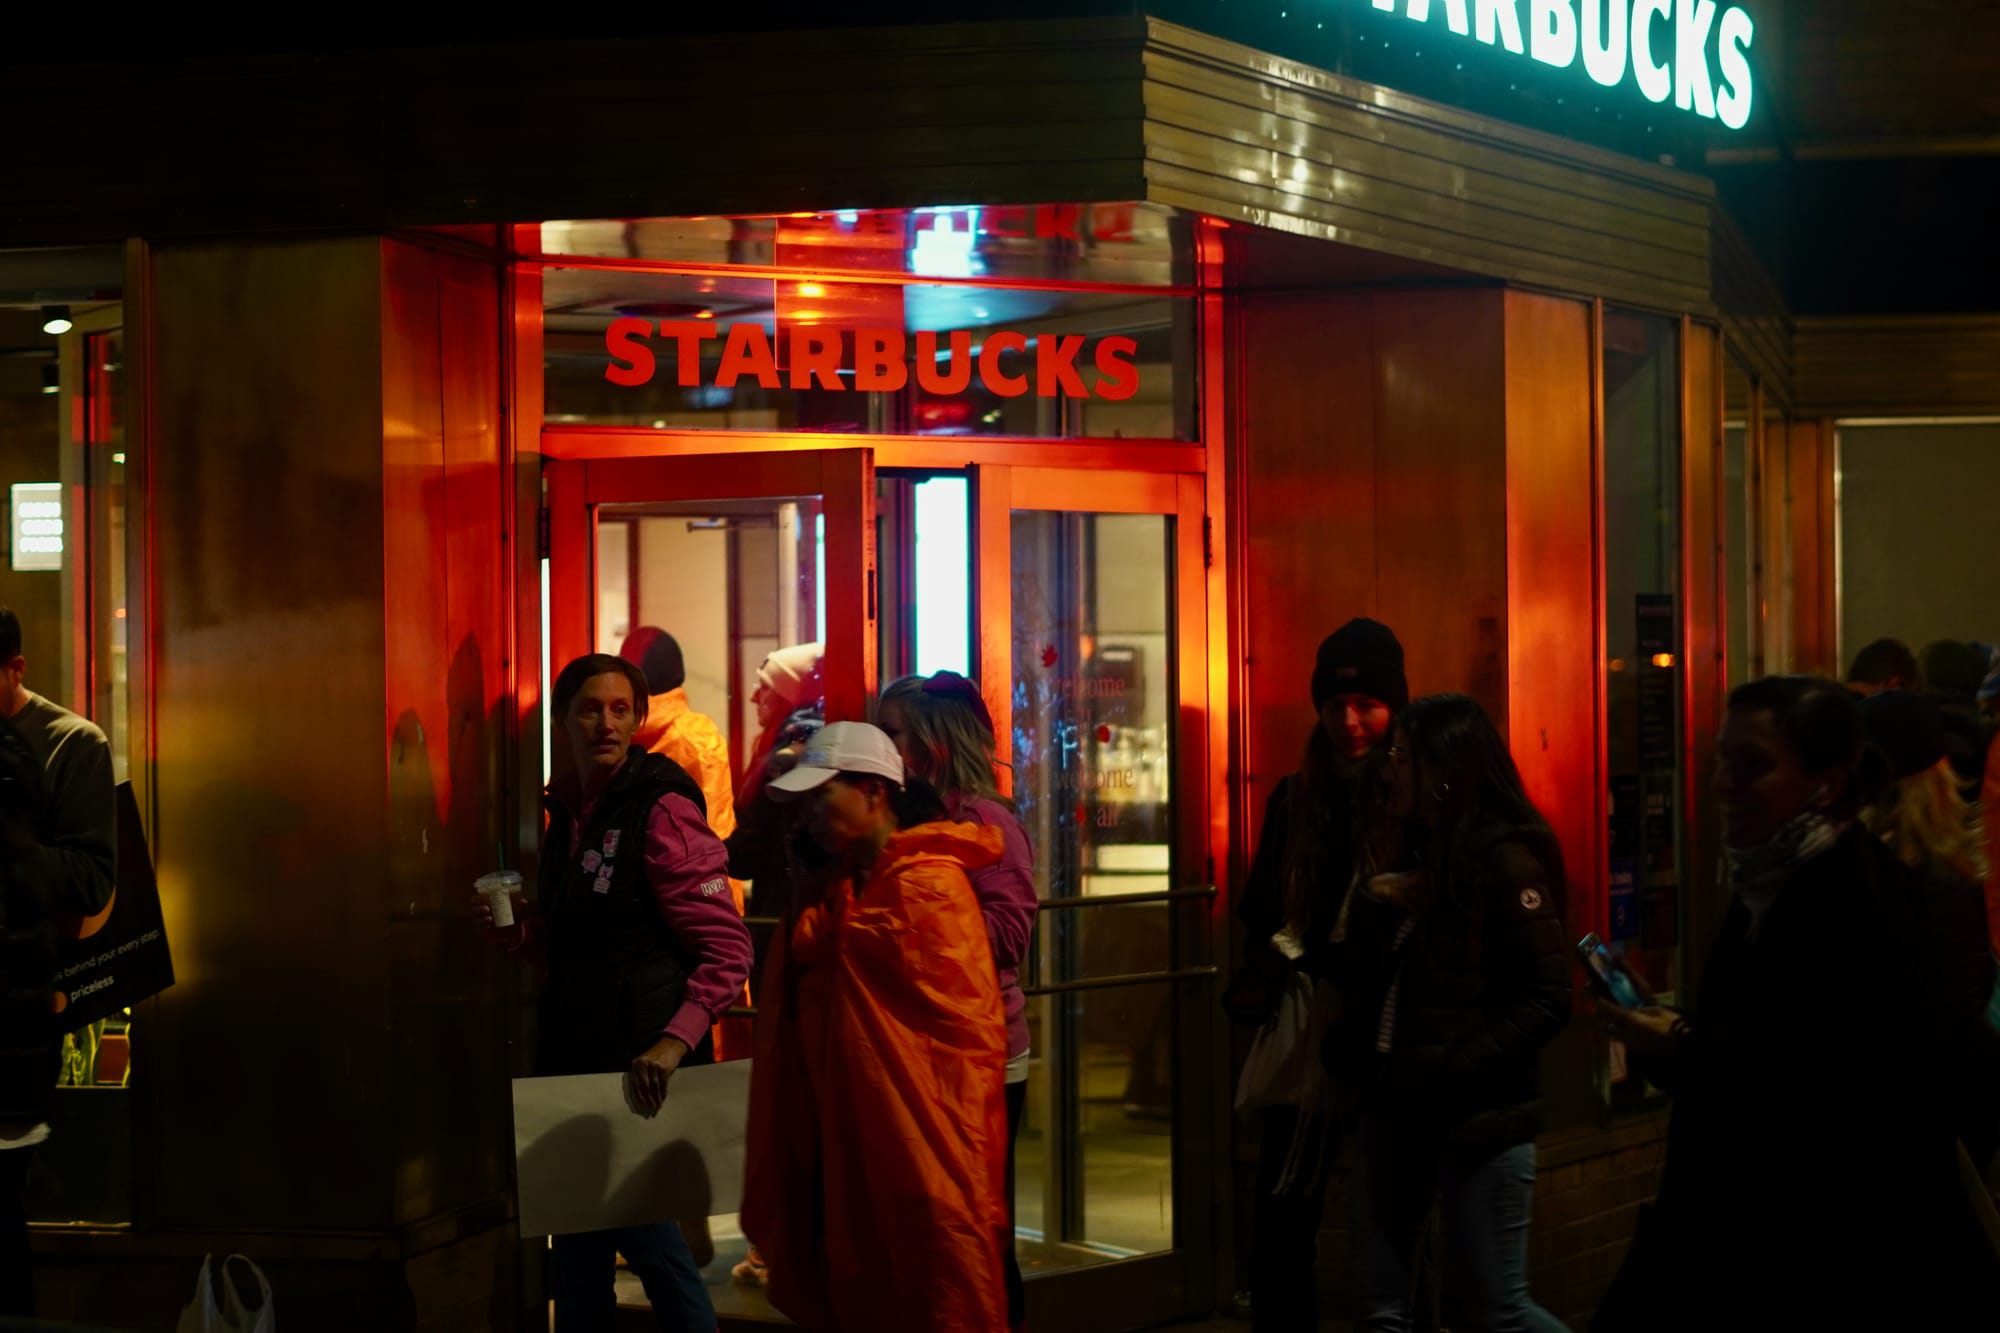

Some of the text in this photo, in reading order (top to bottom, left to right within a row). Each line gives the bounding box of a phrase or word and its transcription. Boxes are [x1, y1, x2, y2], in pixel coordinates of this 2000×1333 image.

[604, 318, 1139, 401] STARBUCKS
[64, 955, 96, 977] behind
[96, 948, 117, 967] your
[117, 939, 140, 955] every
[70, 975, 115, 1004] priceless
